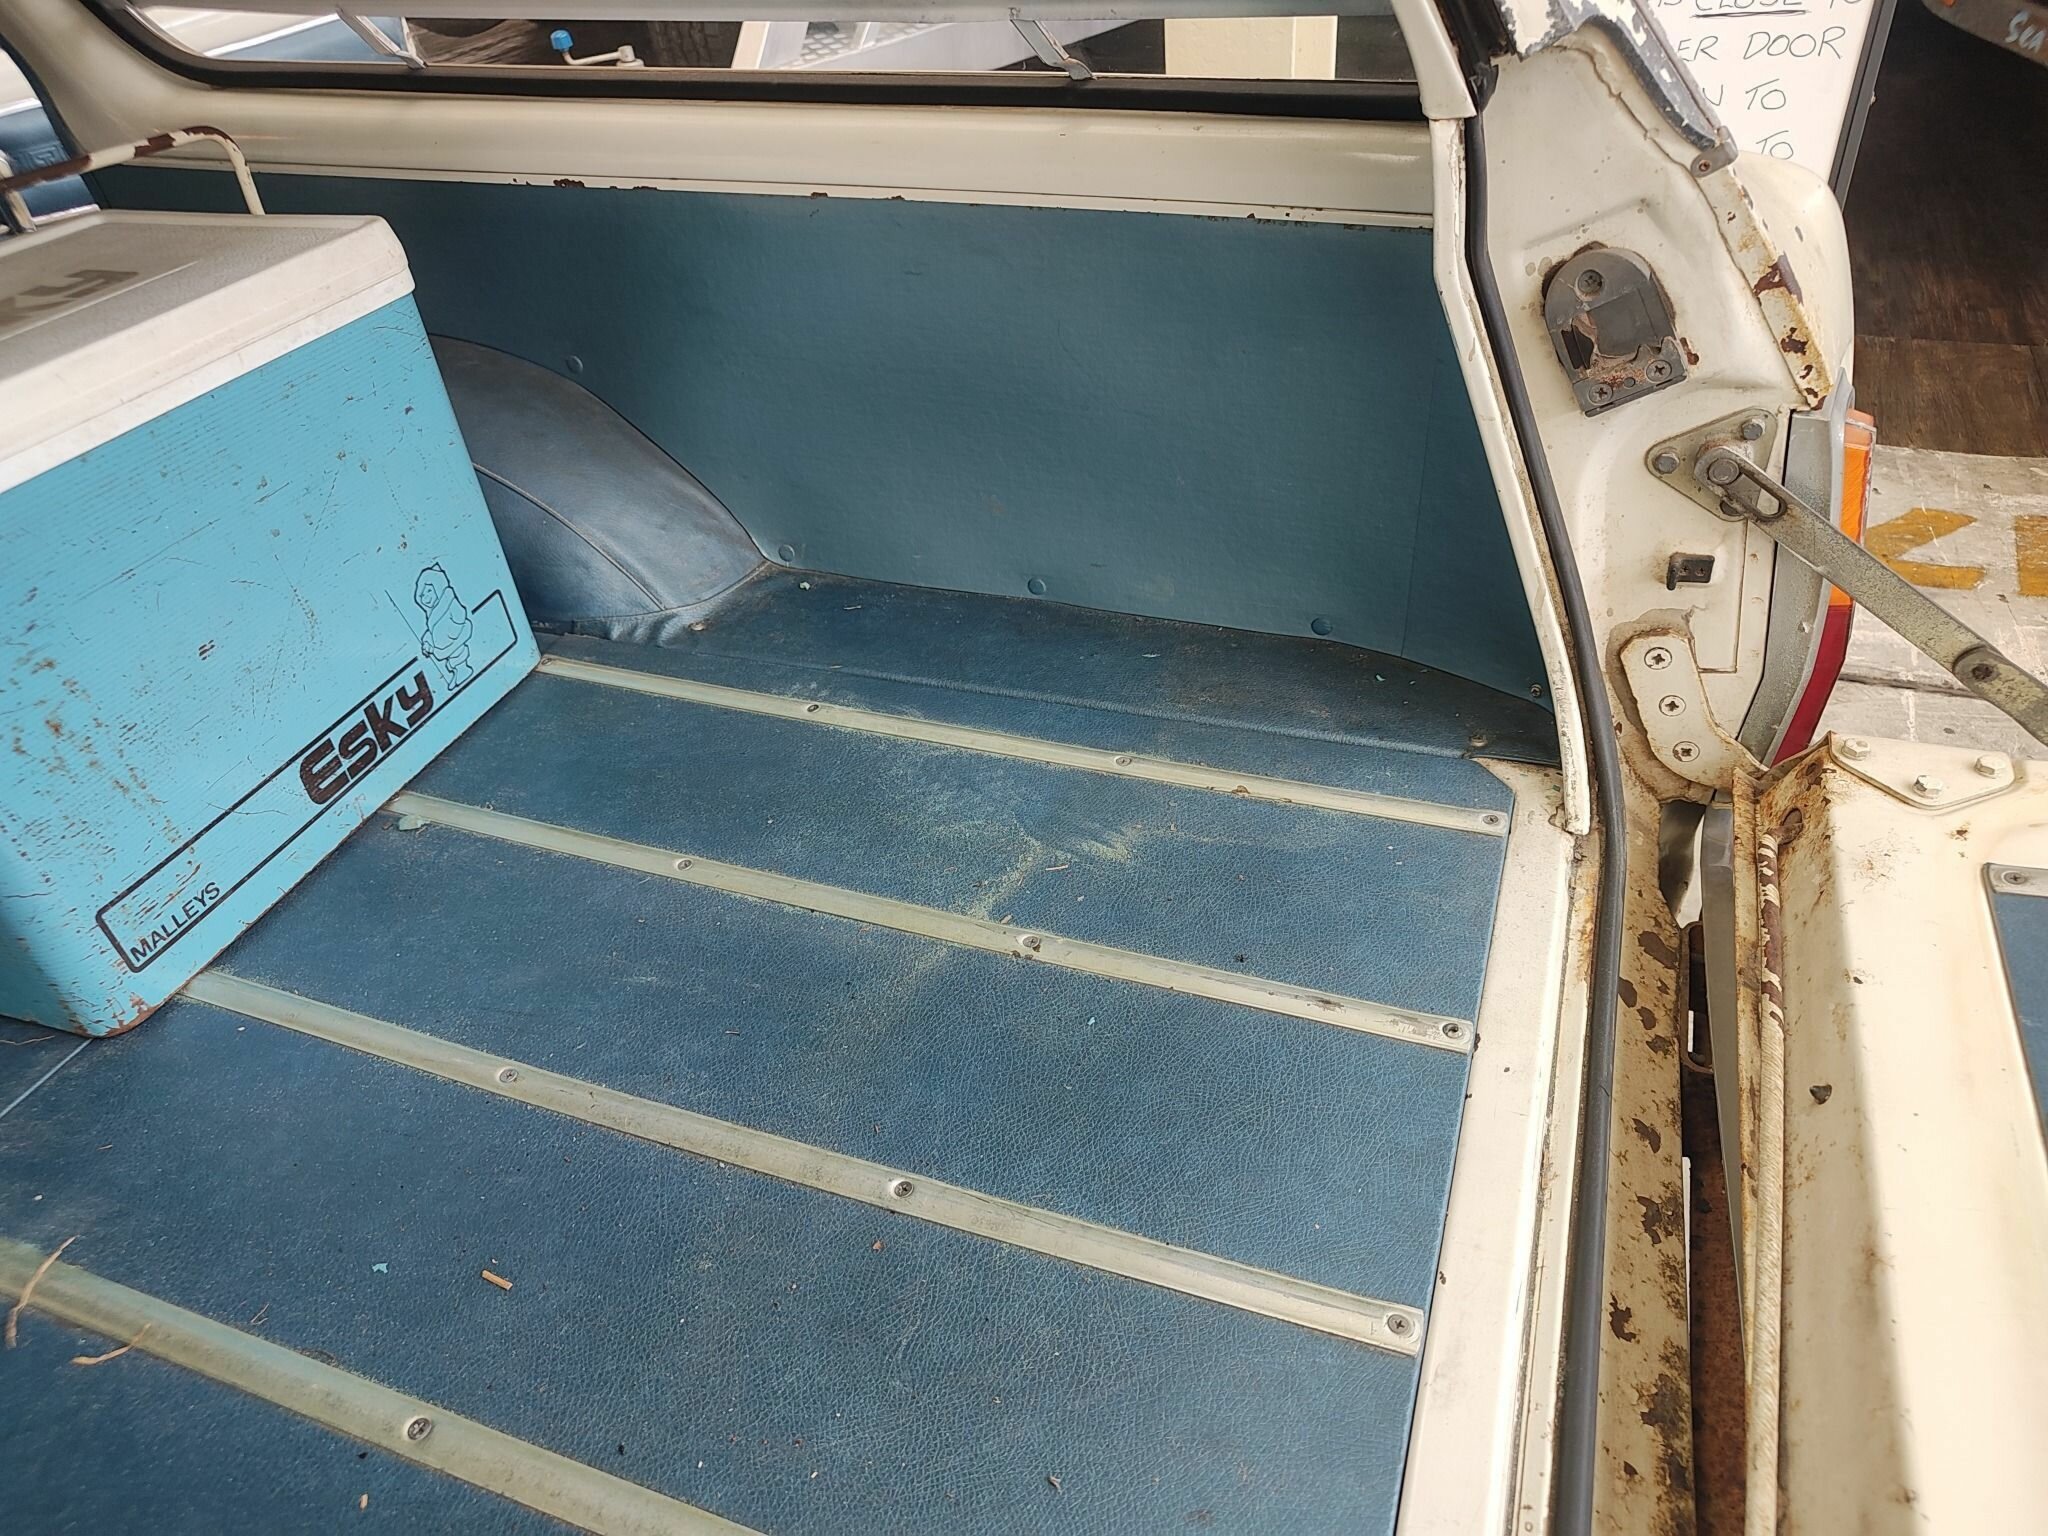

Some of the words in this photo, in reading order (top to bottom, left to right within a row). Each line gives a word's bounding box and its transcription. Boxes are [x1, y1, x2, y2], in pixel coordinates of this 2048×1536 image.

[1743, 26, 1846, 60] DOOR
[1745, 78, 1787, 111] TO
[1755, 130, 1794, 160] TO
[129, 881, 221, 963] MALLEYS
